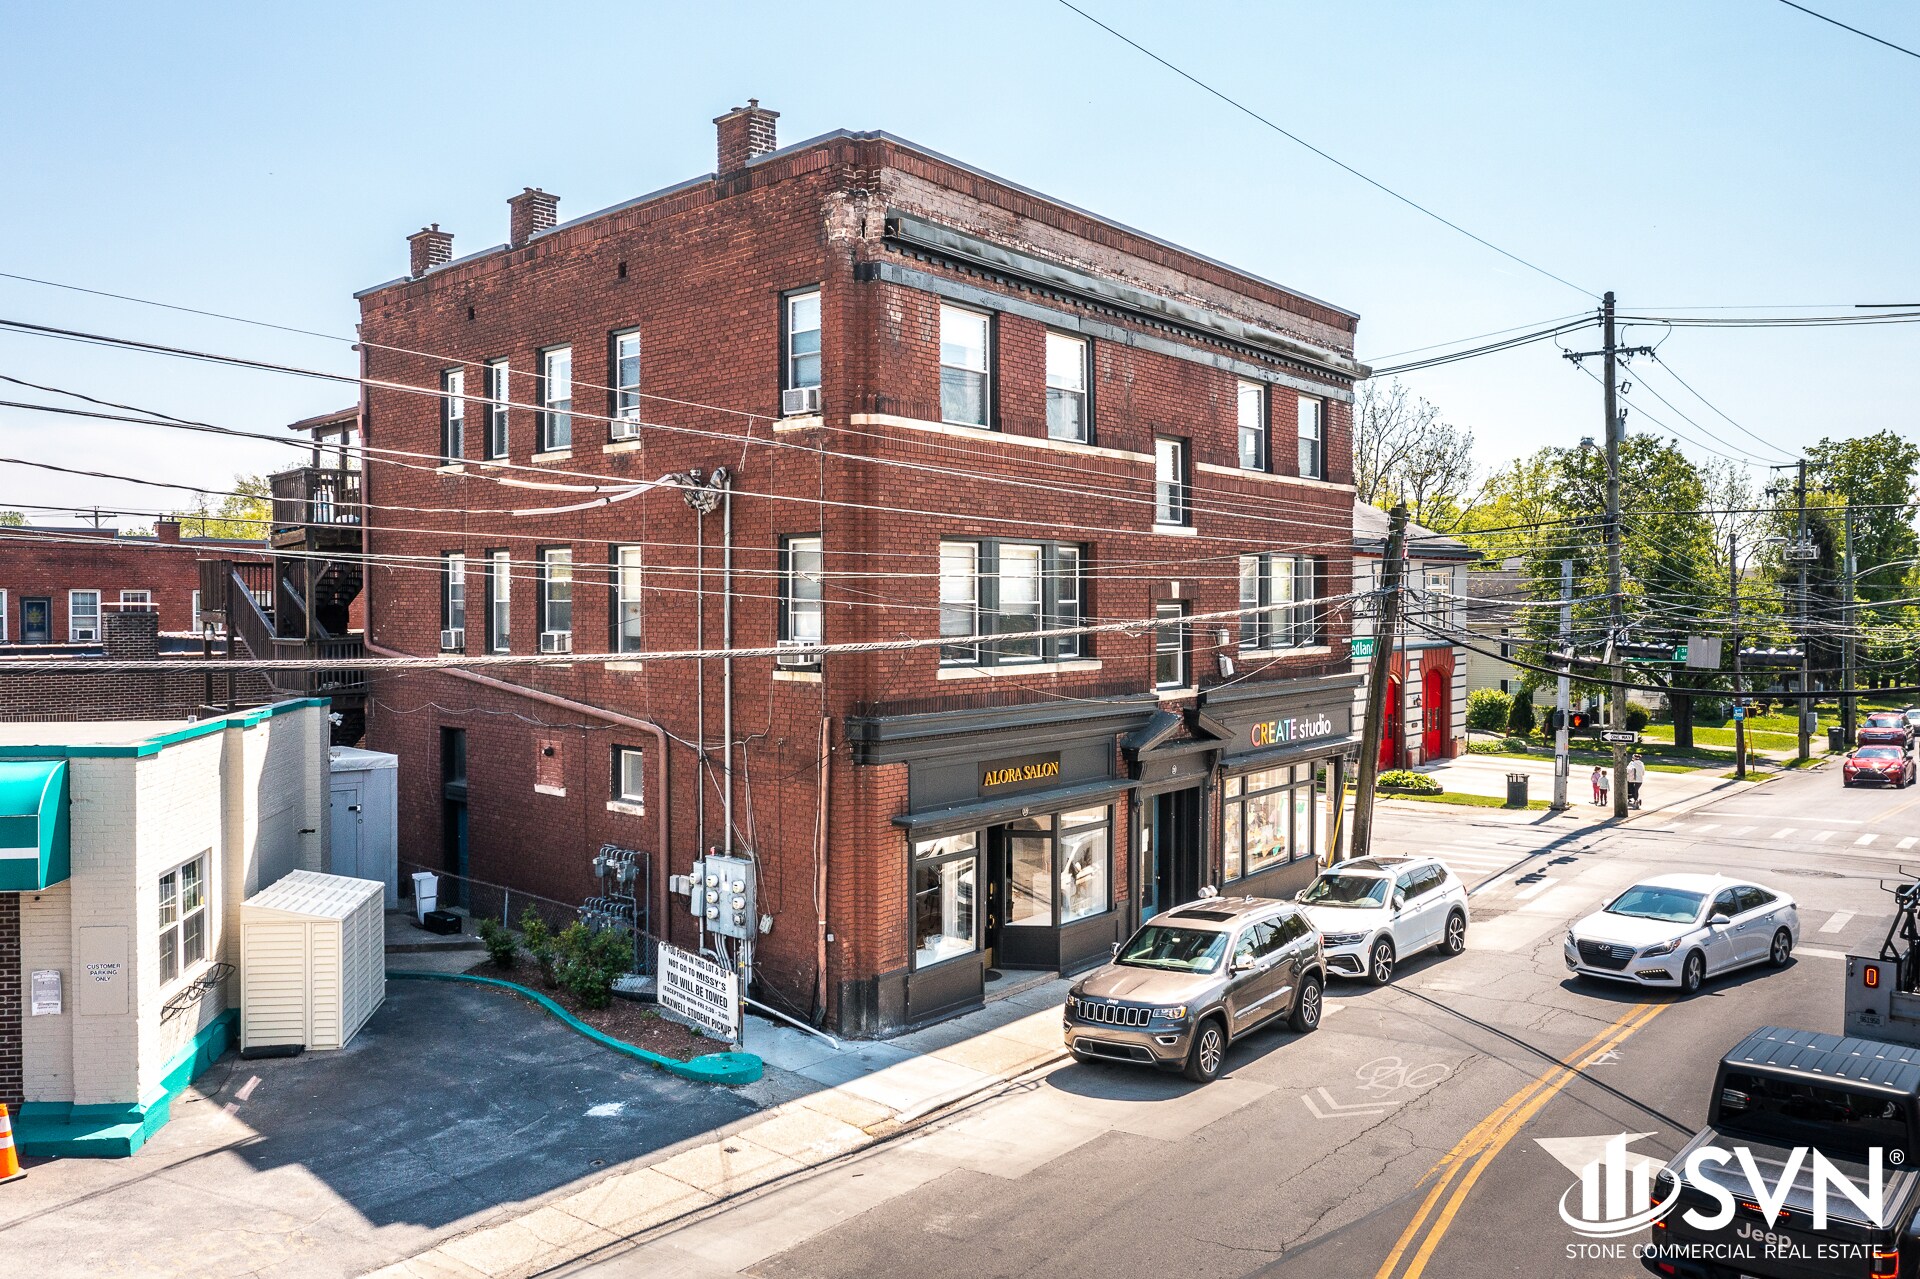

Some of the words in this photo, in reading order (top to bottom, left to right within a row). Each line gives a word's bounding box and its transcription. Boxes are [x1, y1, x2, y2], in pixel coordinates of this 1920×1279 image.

[1251, 718, 1297, 747] CREATE
[1299, 713, 1331, 739] studio
[984, 767, 1022, 787] ALORA
[1023, 761, 1059, 780] SALON
[668, 957, 679, 969] NOT
[679, 962, 687, 973] GO
[688, 967, 695, 977] TO
[696, 971, 727, 991] MISSY'S
[676, 949, 688, 962] PARK
[688, 955, 694, 965] IN
[694, 957, 705, 970] THIS
[705, 962, 714, 973] LOT
[714, 967, 719, 976] &
[666, 970, 679, 985] YOU
[679, 976, 694, 993] WILL
[695, 984, 704, 998] BE
[704, 988, 728, 1009] TOWED
[662, 994, 686, 1014] MAXWELL
[687, 1006, 711, 1025] STUDENT
[711, 1018, 732, 1036] PICKUP
[1737, 1223, 1792, 1251] Jeep
